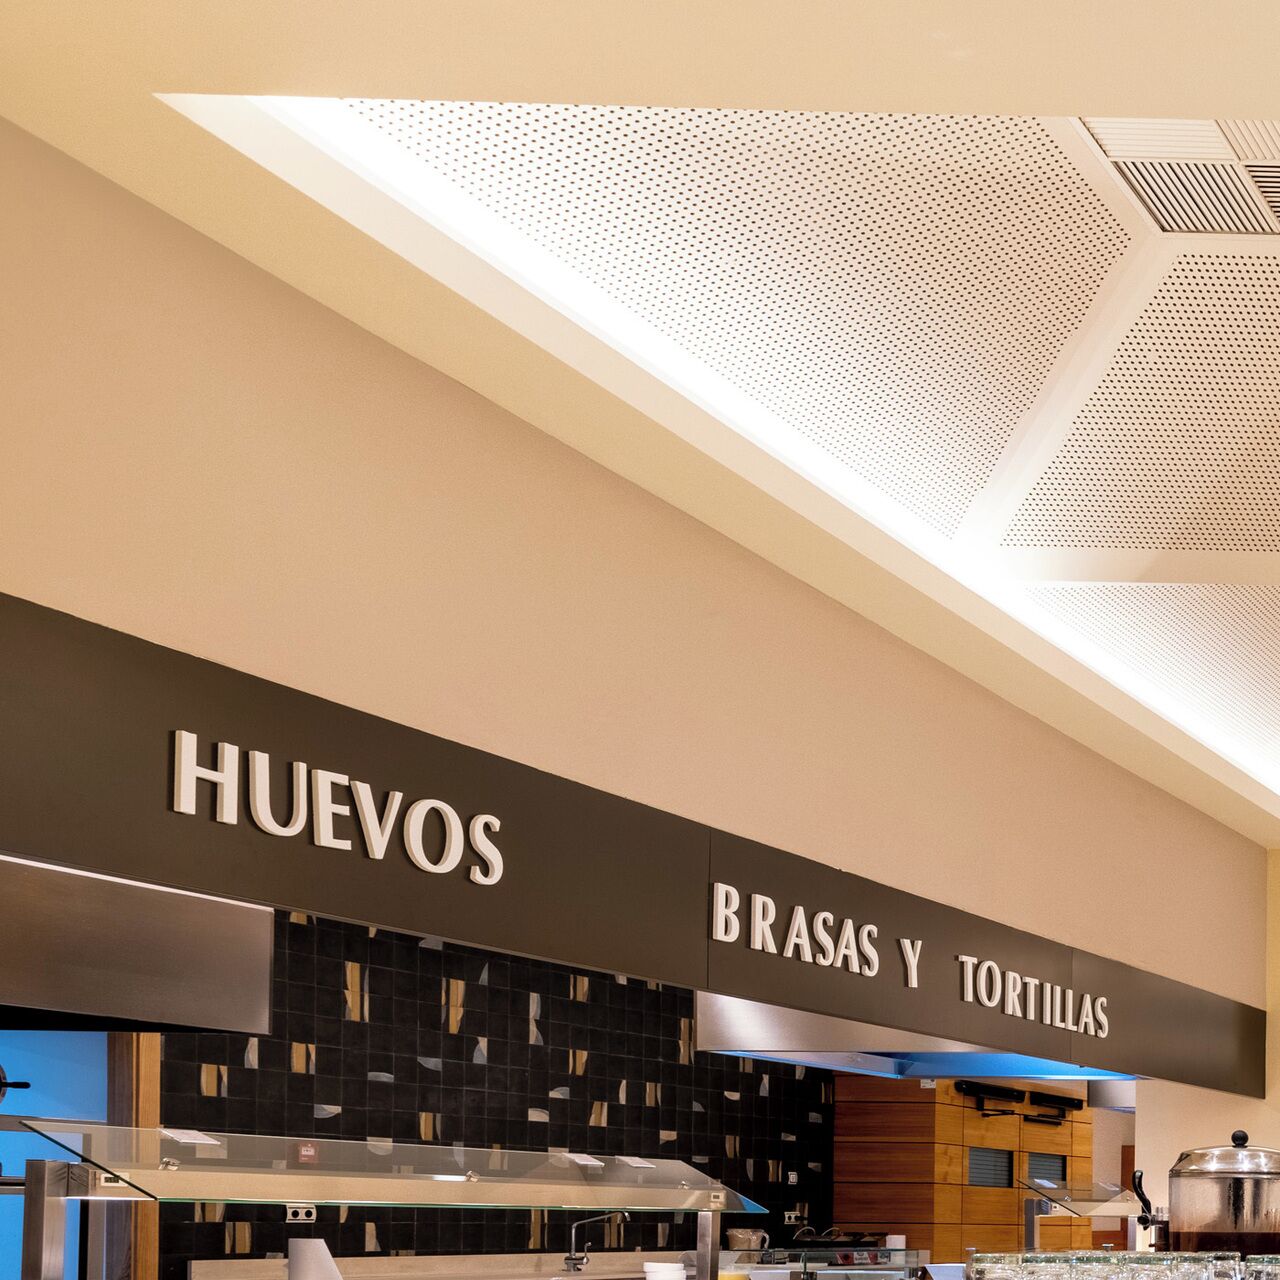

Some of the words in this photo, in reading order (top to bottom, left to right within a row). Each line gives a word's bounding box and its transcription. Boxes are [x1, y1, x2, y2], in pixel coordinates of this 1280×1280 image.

[173, 730, 504, 886] HUEVOS
[712, 882, 880, 978] BRASAS
[899, 938, 923, 988] Y
[956, 954, 1109, 1039] TORTILLAS
